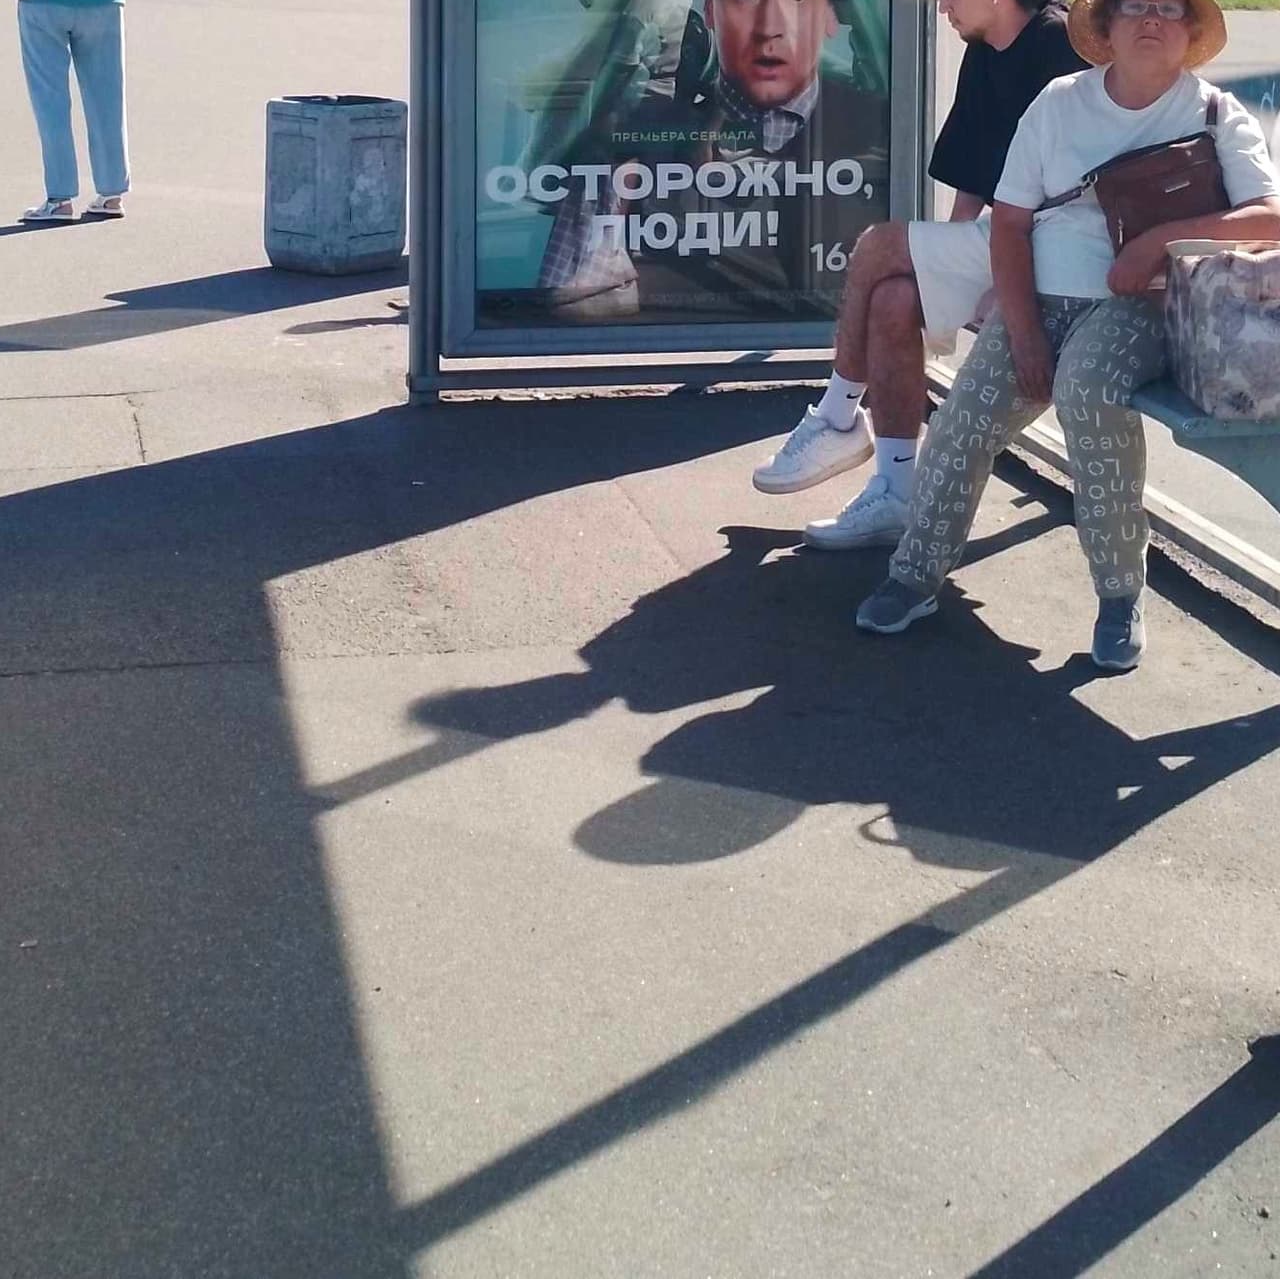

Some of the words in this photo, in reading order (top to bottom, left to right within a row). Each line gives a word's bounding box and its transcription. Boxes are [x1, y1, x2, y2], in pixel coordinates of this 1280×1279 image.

[611, 131, 686, 143] ПРЕМЬЕРА
[688, 130, 756, 142] СЕРИАЛА
[484, 158, 874, 203] ОСТОРОЖНО,
[587, 210, 780, 257] ЛЮДИ!
[809, 241, 848, 273] 16
